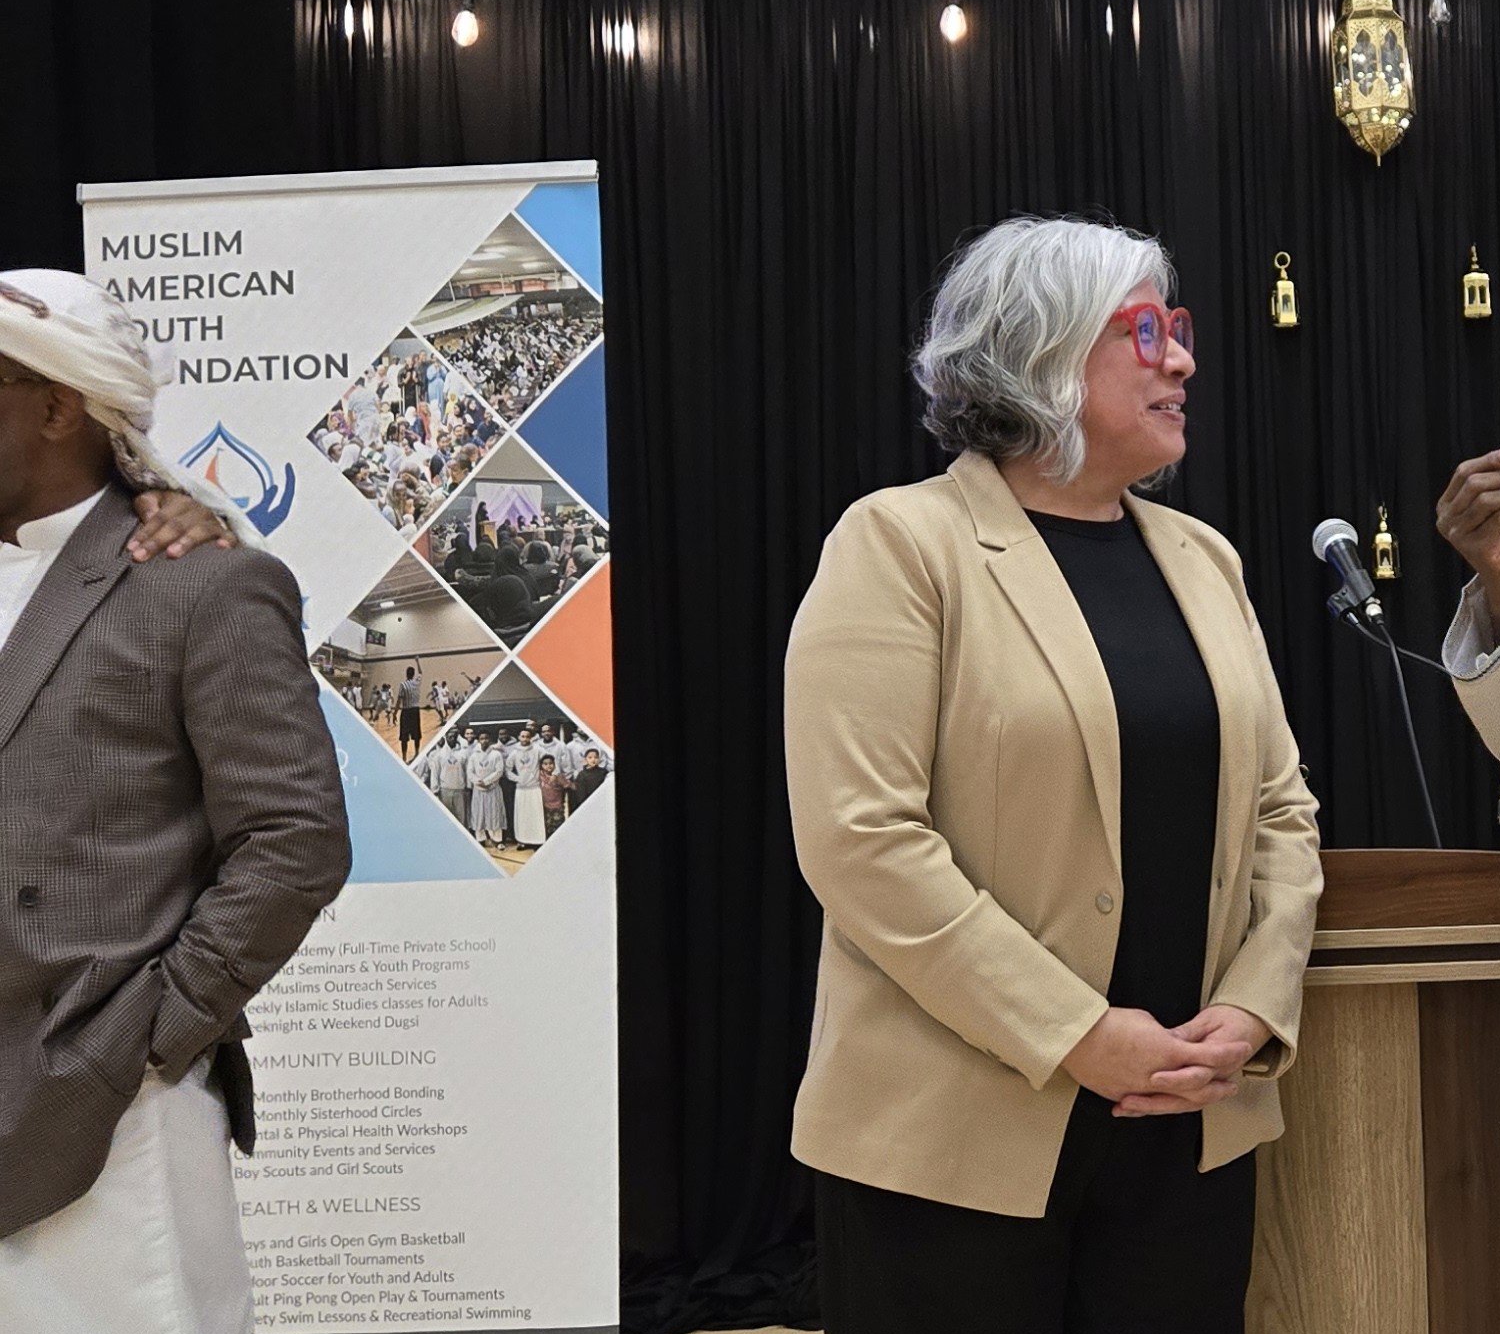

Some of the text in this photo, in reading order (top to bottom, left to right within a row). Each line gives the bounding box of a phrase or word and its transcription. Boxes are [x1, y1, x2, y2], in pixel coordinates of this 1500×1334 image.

[102, 230, 242, 261] MUSLIM
[348, 1049, 437, 1068] BUILDING
[306, 1197, 422, 1215] & WELLNESS
